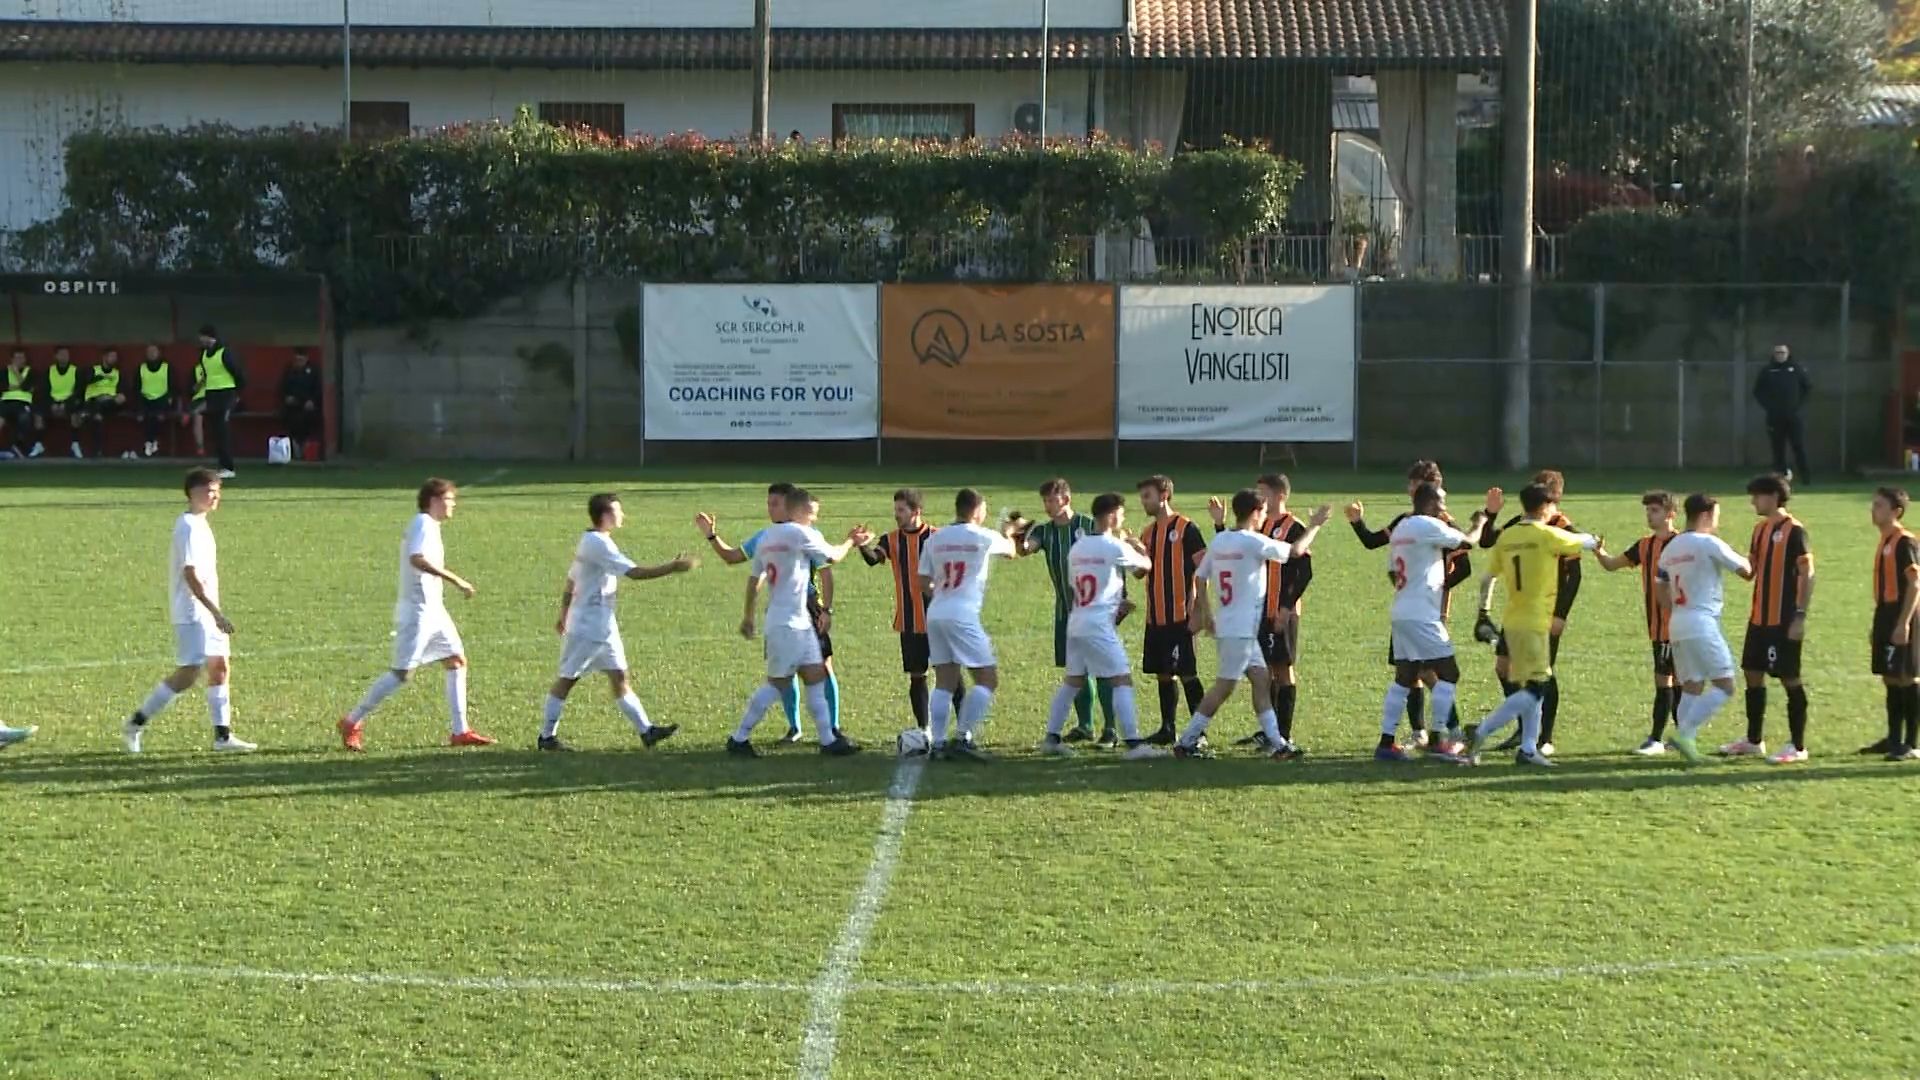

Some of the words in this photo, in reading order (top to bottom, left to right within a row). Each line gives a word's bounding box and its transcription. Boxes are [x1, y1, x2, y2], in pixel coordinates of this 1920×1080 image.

[44, 281, 116, 294] OSPITI
[1192, 303, 1282, 340] ENOTECA
[981, 323, 1007, 342] LA
[1014, 323, 1086, 342] SOSTA
[1185, 347, 1289, 385] VANGELISTI
[669, 386, 765, 402] COACHING
[771, 386, 806, 402] FOR
[811, 386, 854, 402] YOU!
[943, 560, 966, 590] 17
[1512, 555, 1522, 591] 1
[1219, 571, 1233, 607] 5
[1171, 644, 1180, 660] 4
[1767, 645, 1777, 661] 6
[1885, 645, 1896, 661] 7
